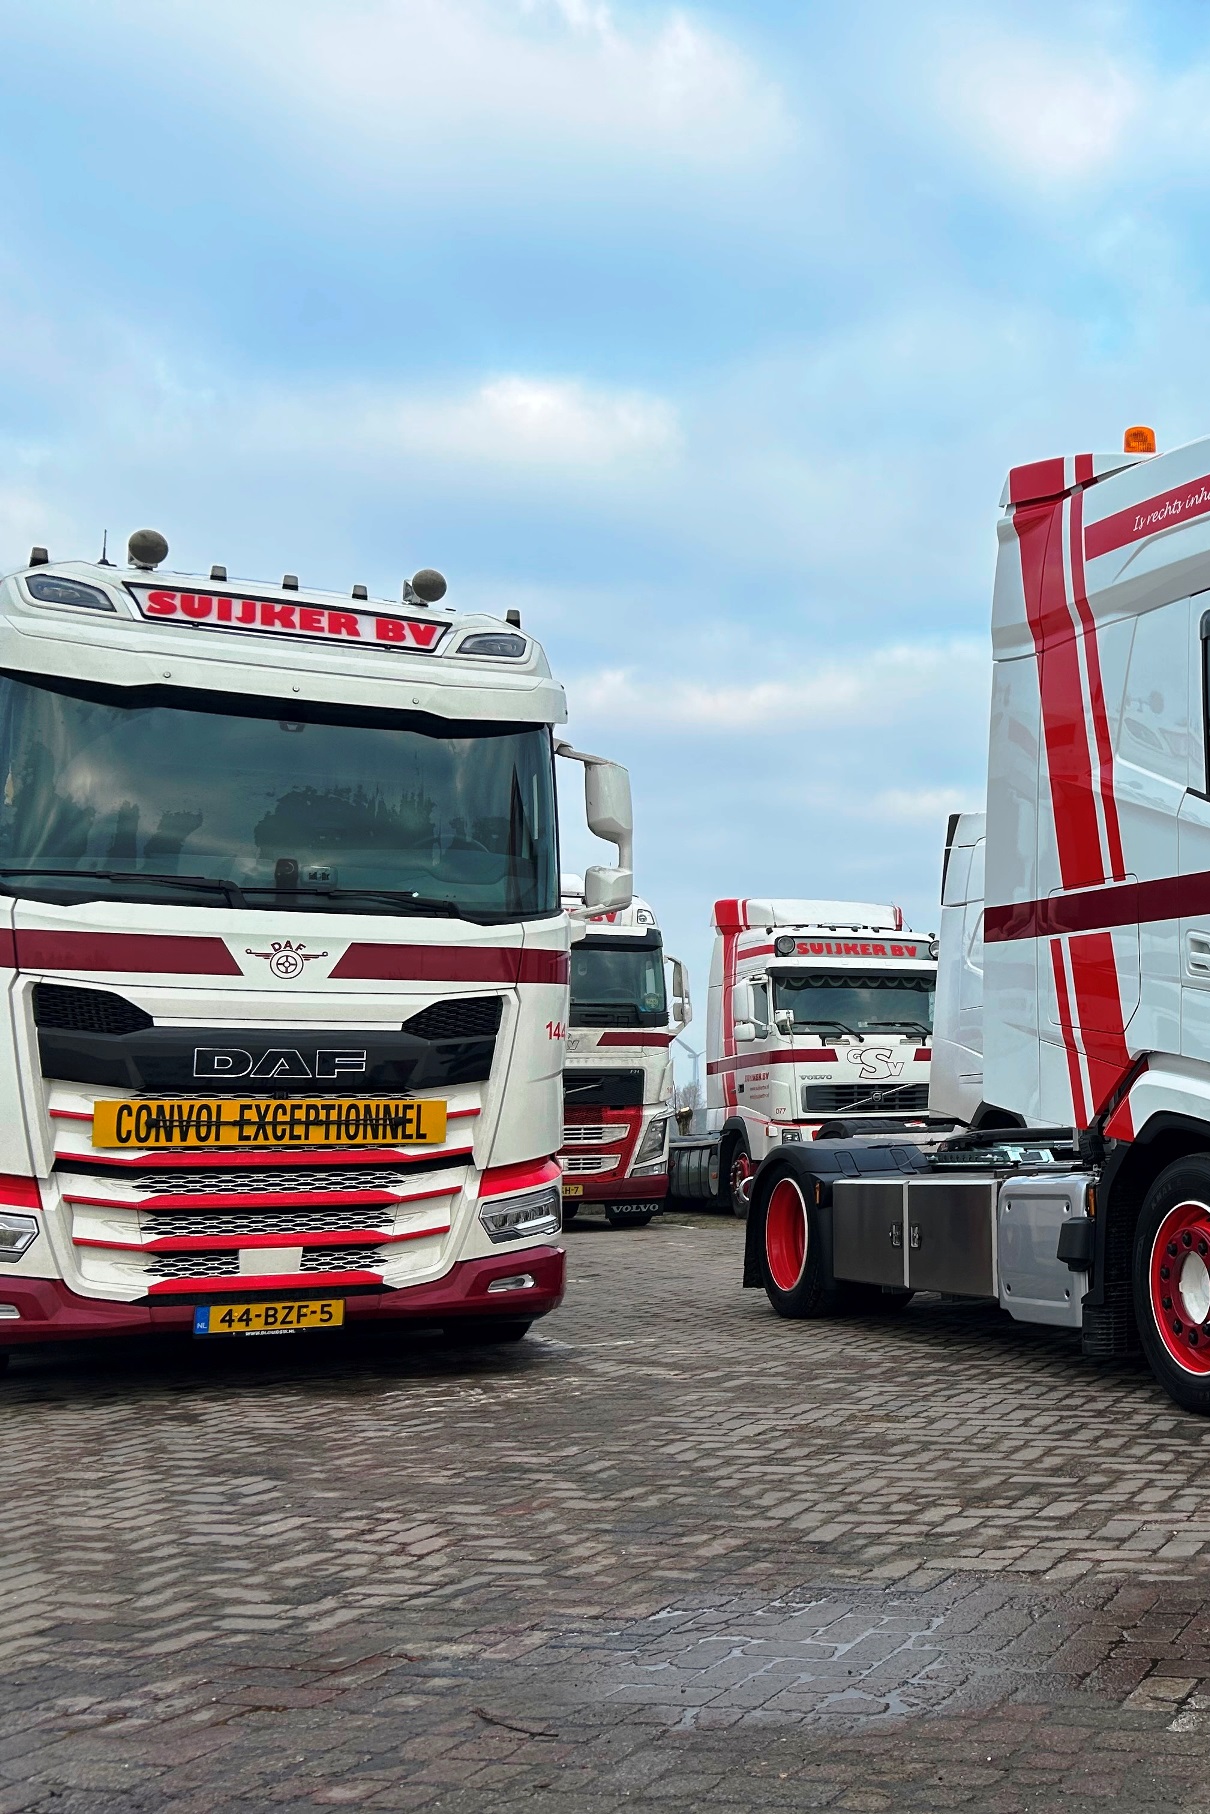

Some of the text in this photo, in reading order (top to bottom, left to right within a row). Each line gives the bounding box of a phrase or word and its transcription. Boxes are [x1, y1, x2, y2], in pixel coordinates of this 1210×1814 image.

[1132, 515, 1146, 532] Is
[1146, 499, 1185, 526] rechts
[146, 589, 438, 646] SUIJKER BV
[270, 939, 307, 953] DAF
[796, 942, 917, 957] SUIJKER BV
[545, 1020, 567, 1041] 144
[193, 1047, 367, 1079] DAF
[115, 1103, 428, 1144] CONVOI EXCEPTIONNEL
[611, 1203, 659, 1214] VOLVO
[219, 1303, 333, 1328] 44-BZF-5
